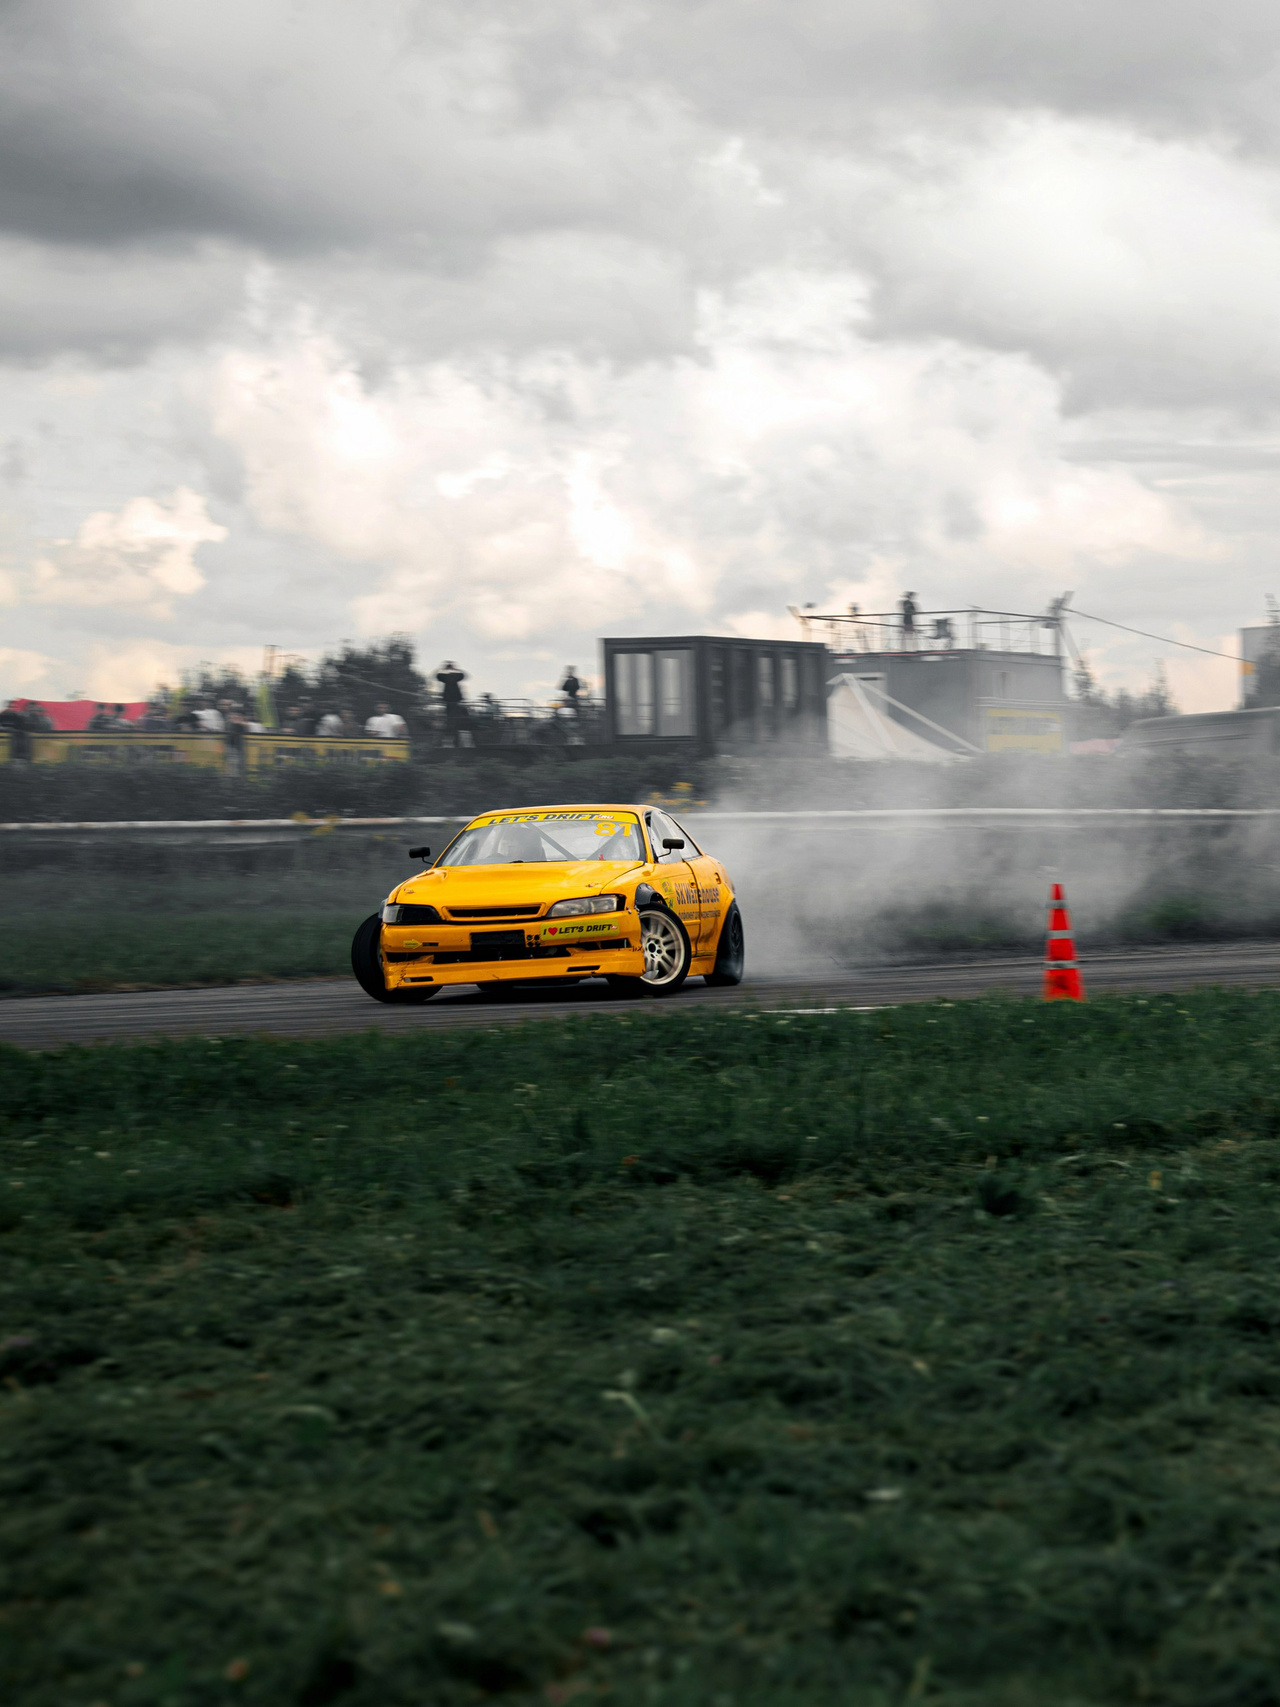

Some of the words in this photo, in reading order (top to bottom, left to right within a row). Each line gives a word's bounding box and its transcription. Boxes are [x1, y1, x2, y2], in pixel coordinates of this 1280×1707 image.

[488, 814, 540, 825] LET'S
[593, 821, 632, 837] 81
[542, 928, 548, 936] I
[558, 925, 584, 935] LET'S
